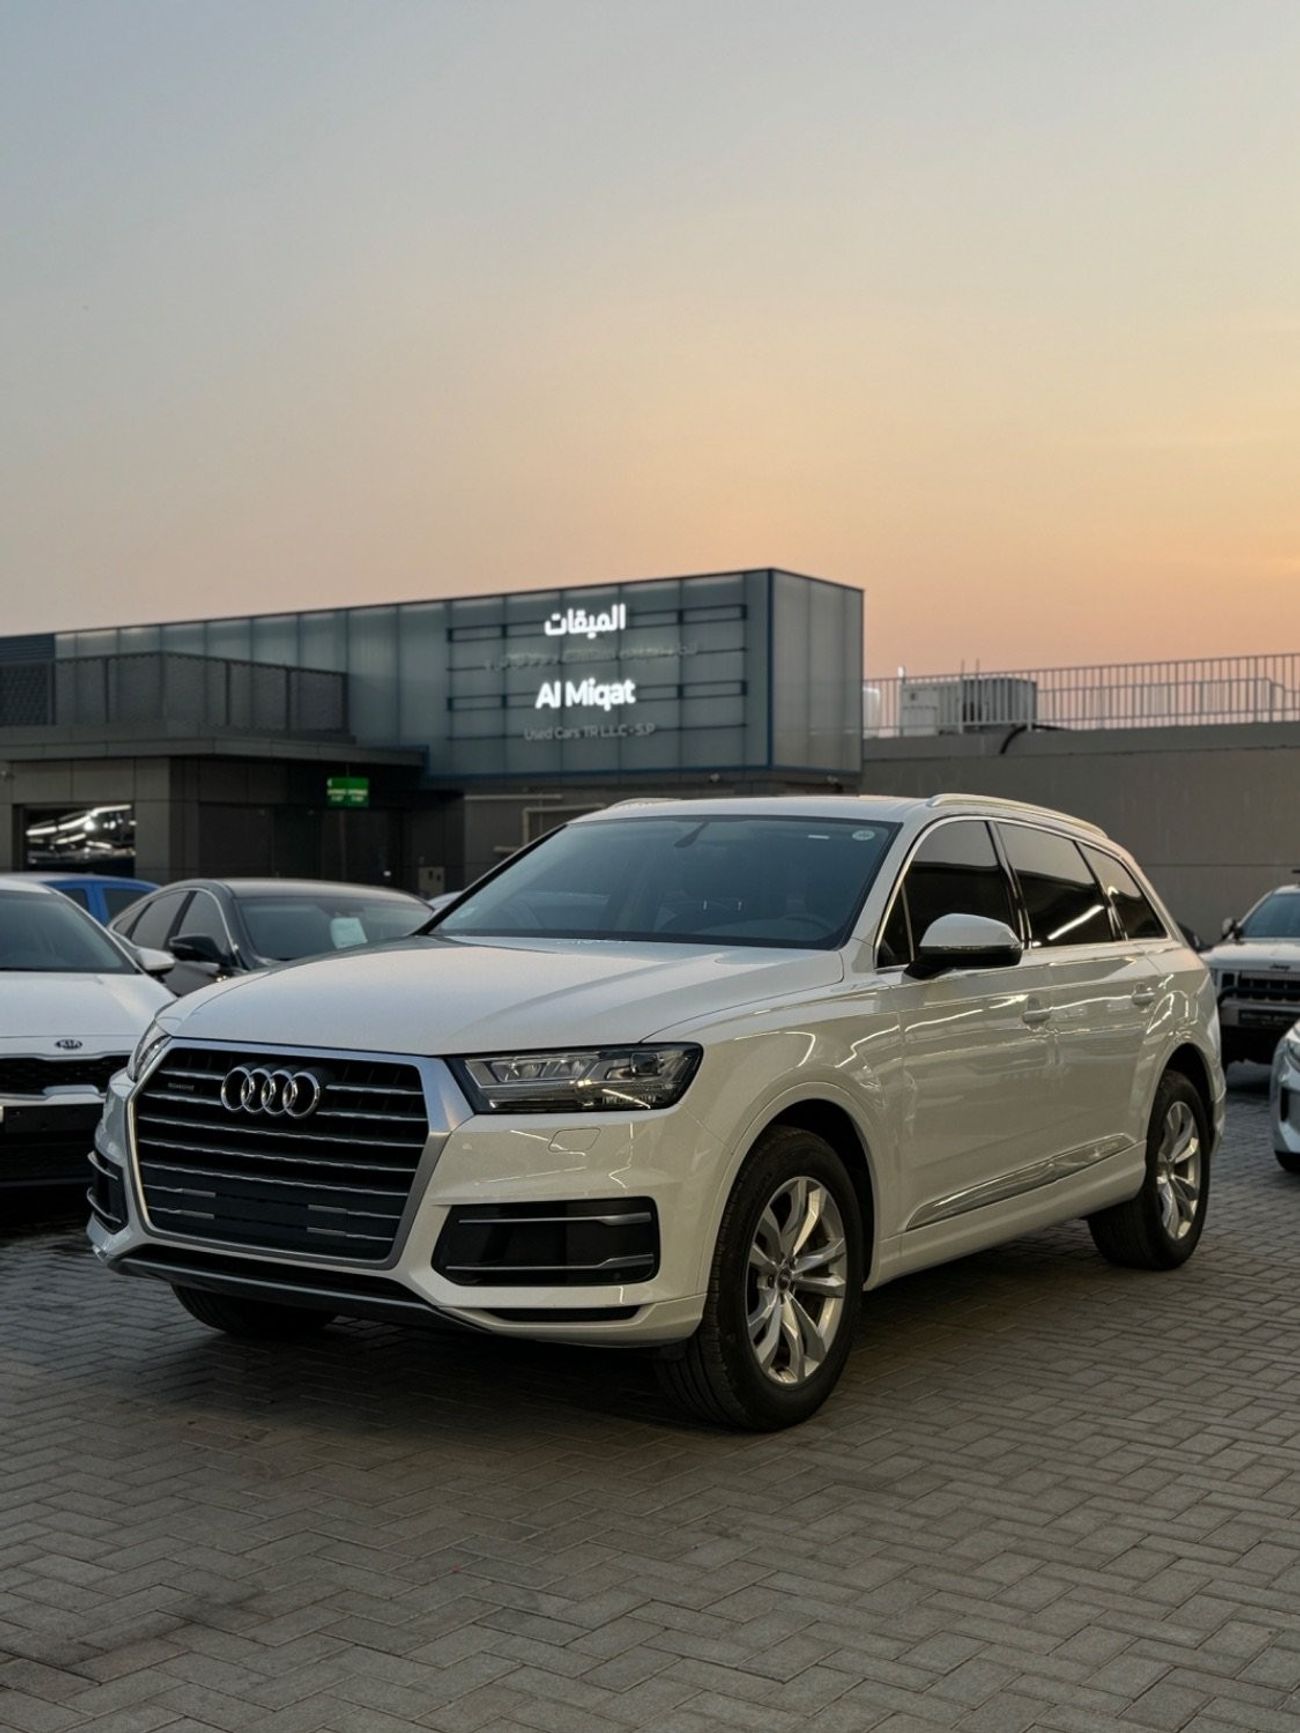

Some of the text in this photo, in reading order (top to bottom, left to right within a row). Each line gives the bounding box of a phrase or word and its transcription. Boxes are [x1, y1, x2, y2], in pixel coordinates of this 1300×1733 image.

[544, 603, 626, 639] الميقات
[535, 677, 636, 712] Al Miqat
[524, 726, 553, 740] Used
[554, 726, 580, 739] Cars
